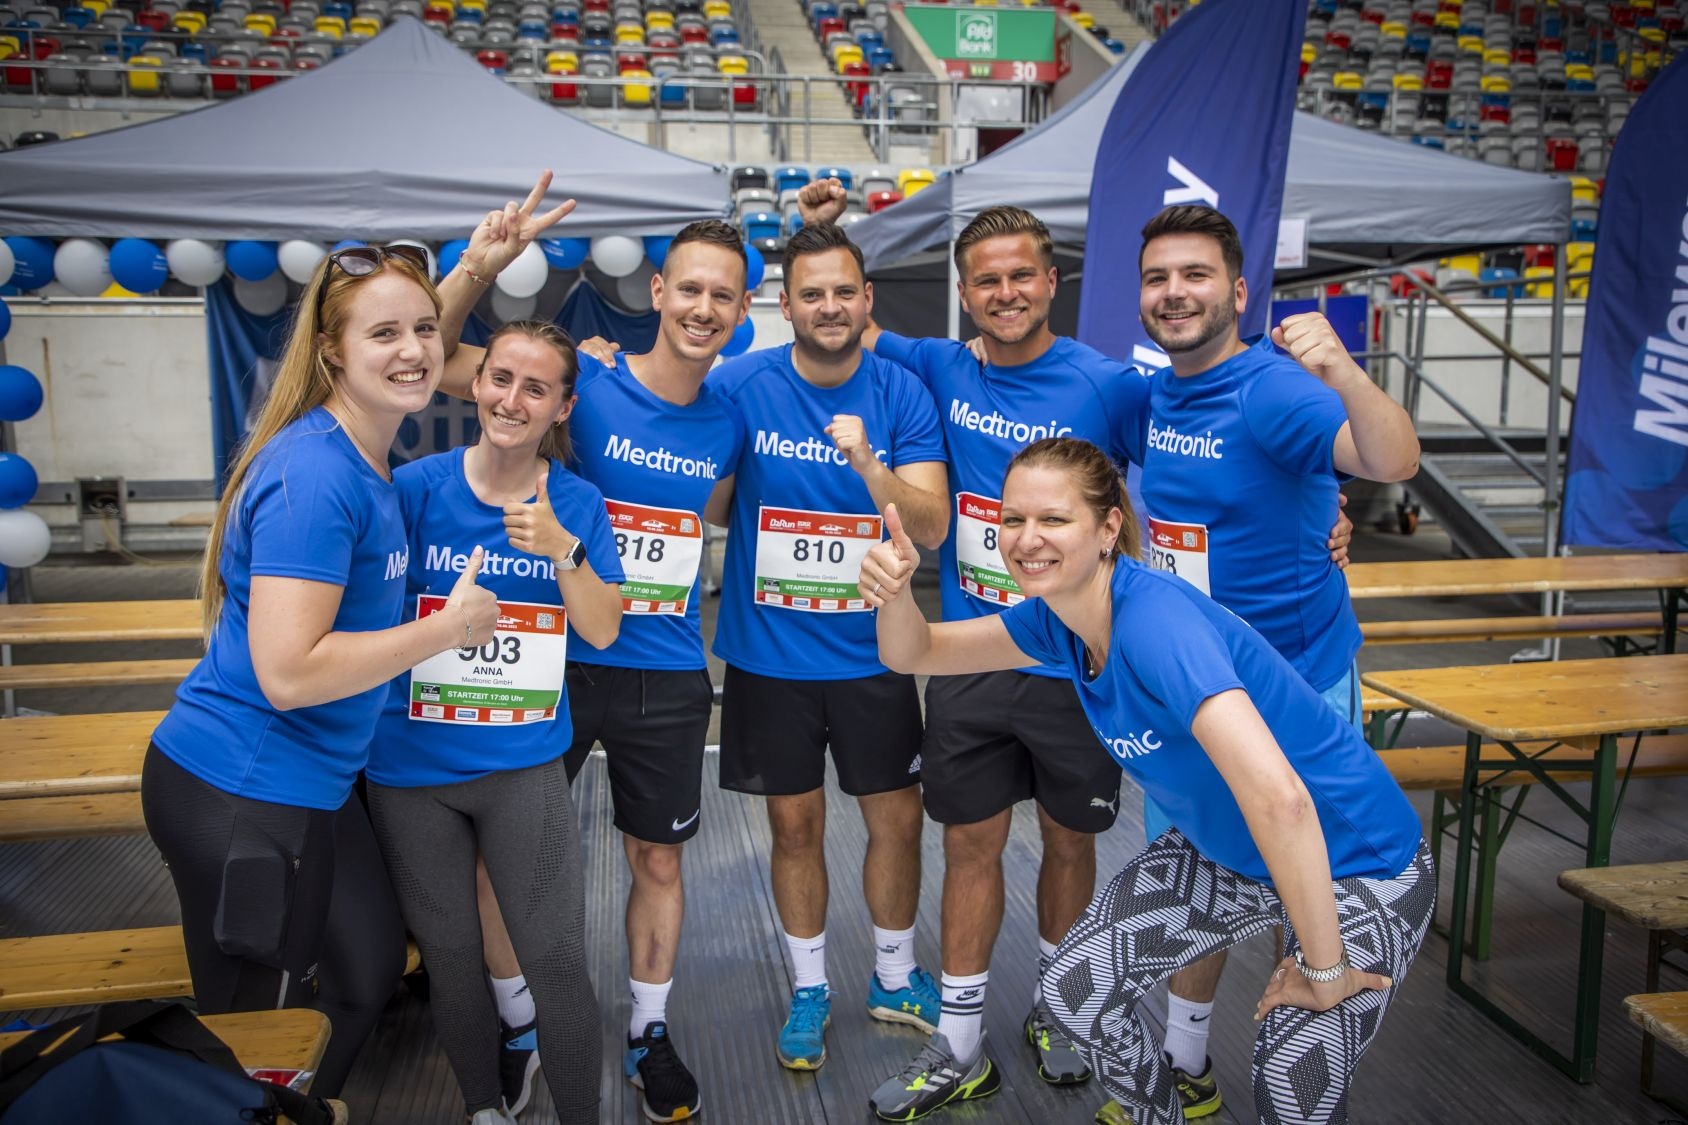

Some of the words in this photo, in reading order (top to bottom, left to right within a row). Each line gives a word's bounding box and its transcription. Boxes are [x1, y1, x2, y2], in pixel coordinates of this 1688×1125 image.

[1012, 61, 1038, 82] 30
[754, 429, 887, 467] Medtroc
[1147, 419, 1224, 460] edtronic
[604, 434, 717, 480] Medtronic
[614, 533, 665, 563] 818
[793, 538, 845, 563] 810
[425, 545, 556, 580] Medtroni
[785, 584, 819, 592] STARTZEIT
[457, 636, 521, 664] 903
[461, 676, 492, 685] Medtronic
[493, 678, 513, 686] GmbH
[472, 666, 503, 677] ANNA
[447, 690, 489, 700] STARTZEIT
[490, 693, 510, 701] 17:00
[510, 694, 524, 702] Uhr
[1101, 729, 1162, 759] ronic
